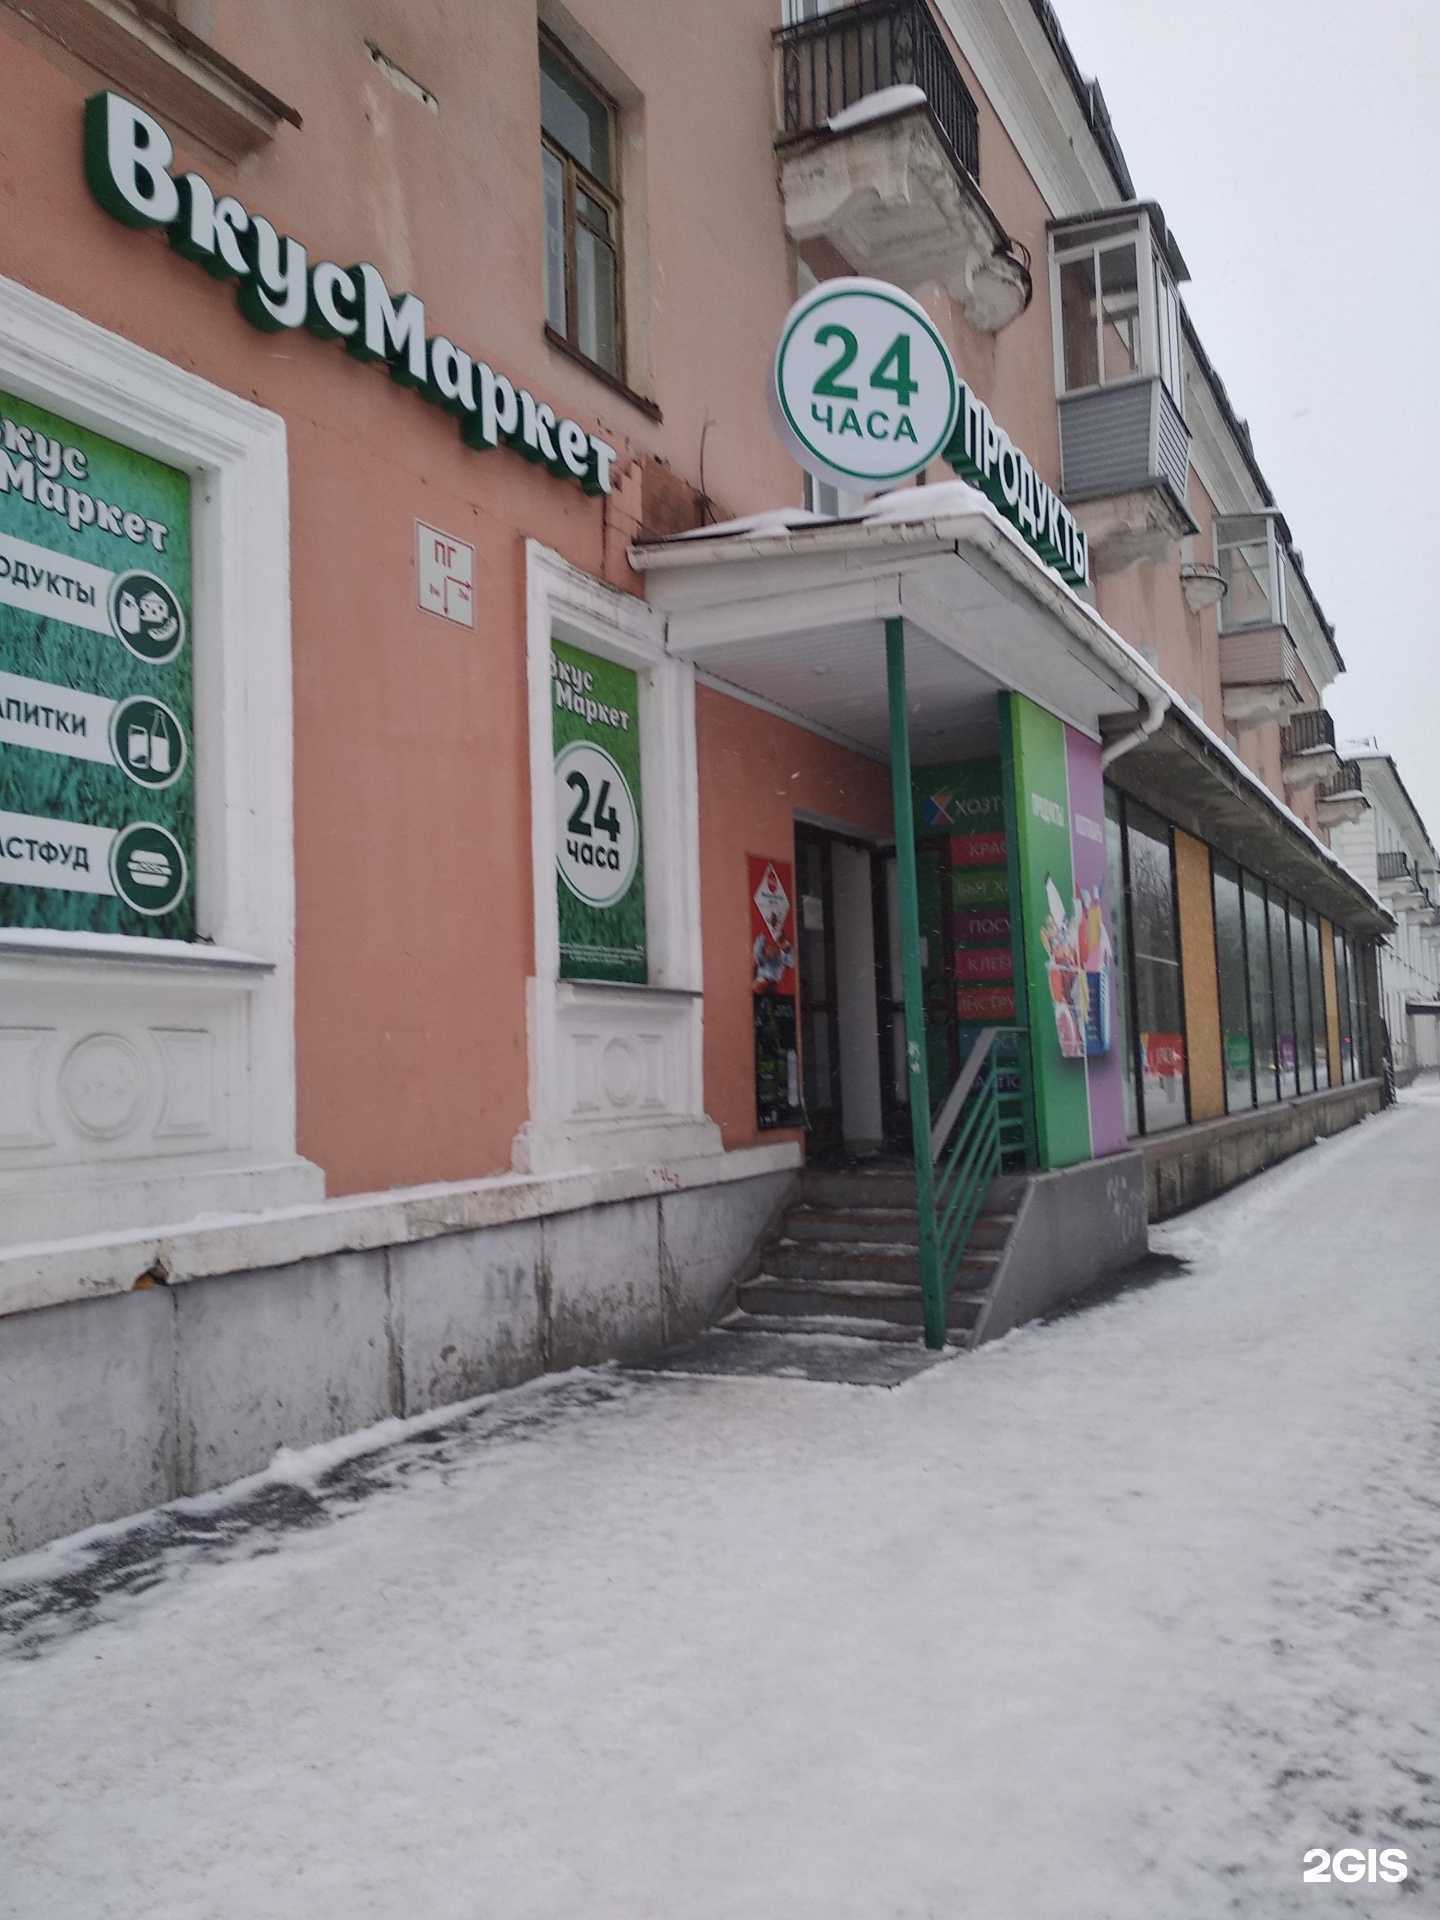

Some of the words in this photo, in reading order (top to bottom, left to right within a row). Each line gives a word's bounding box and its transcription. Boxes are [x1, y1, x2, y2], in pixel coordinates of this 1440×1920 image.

[811, 323, 919, 408] 24
[810, 403, 919, 445] ЧАСА
[0, 418, 88, 480] кус
[963, 390, 1090, 587] ПРОДУКТЫ
[434, 539, 456, 569] ПГ
[0, 696, 87, 738] ПИТКИ
[555, 680, 630, 731] Маркет
[565, 769, 621, 843] 24
[0, 836, 90, 873] СТФУД
[566, 838, 620, 873] часа
